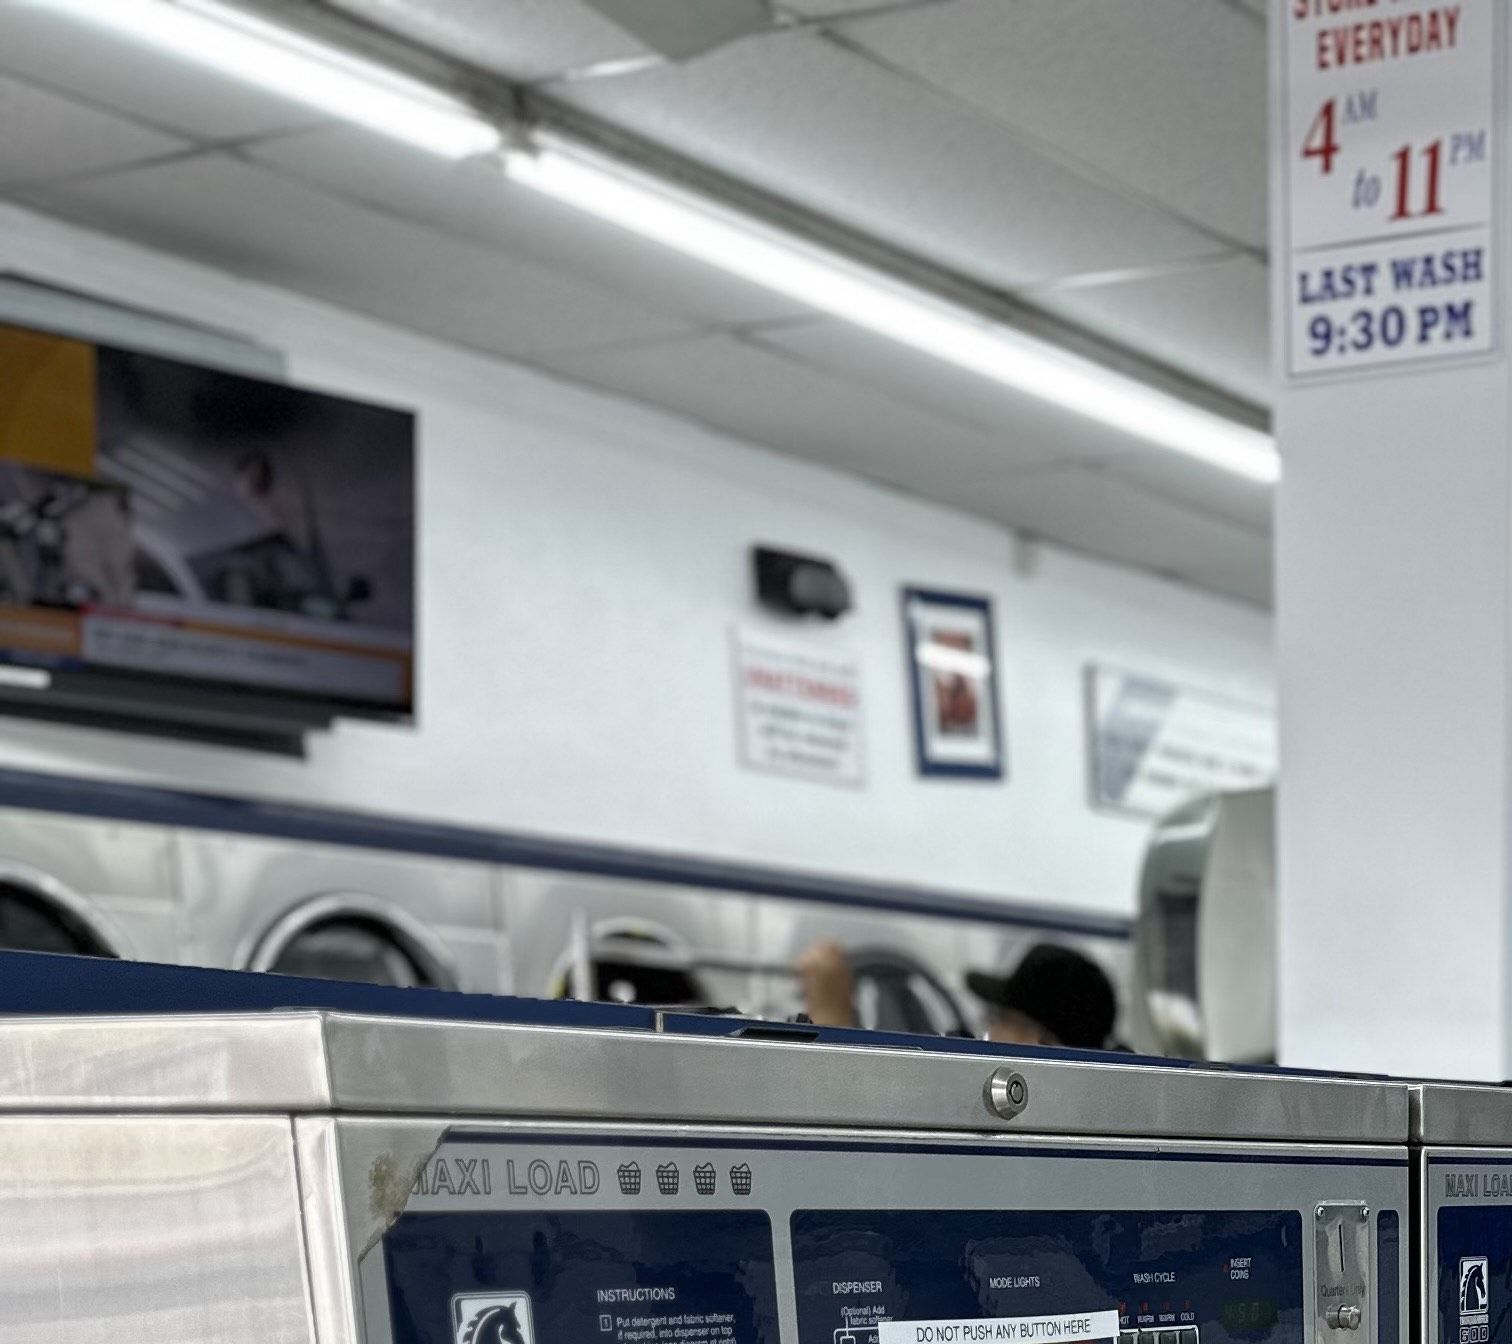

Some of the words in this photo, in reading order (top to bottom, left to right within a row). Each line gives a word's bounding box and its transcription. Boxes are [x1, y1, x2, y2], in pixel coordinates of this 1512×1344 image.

[1317, 6, 1460, 69] EVERYDAY
[1302, 97, 1341, 175] 4
[1342, 88, 1379, 125] AM
[1352, 168, 1381, 209] to
[1388, 138, 1445, 223] 11
[1449, 128, 1487, 166] PM
[1300, 263, 1378, 304] LAST
[1391, 247, 1484, 292] WASH
[1308, 304, 1406, 357] 9:30
[1416, 298, 1473, 345] PM
[506, 1158, 600, 1195] LOAD
[1445, 1173, 1479, 1198] MAXI
[1230, 1258, 1251, 1268] INSERT
[832, 1281, 882, 1294] DISPENSER
[989, 1276, 1012, 1289] MODE
[1013, 1275, 1040, 1288] LIGHTS
[1154, 1271, 1176, 1283] CYCLE
[597, 1287, 675, 1302] INSTRUCTIONS
[616, 1317, 630, 1328] Put
[917, 1326, 934, 1343] DO
[936, 1325, 960, 1342] NOT
[963, 1324, 993, 1341] PUSH
[995, 1323, 1017, 1339] ANY
[1020, 1321, 1062, 1338] BUTTON
[1064, 1319, 1091, 1334] HERE
